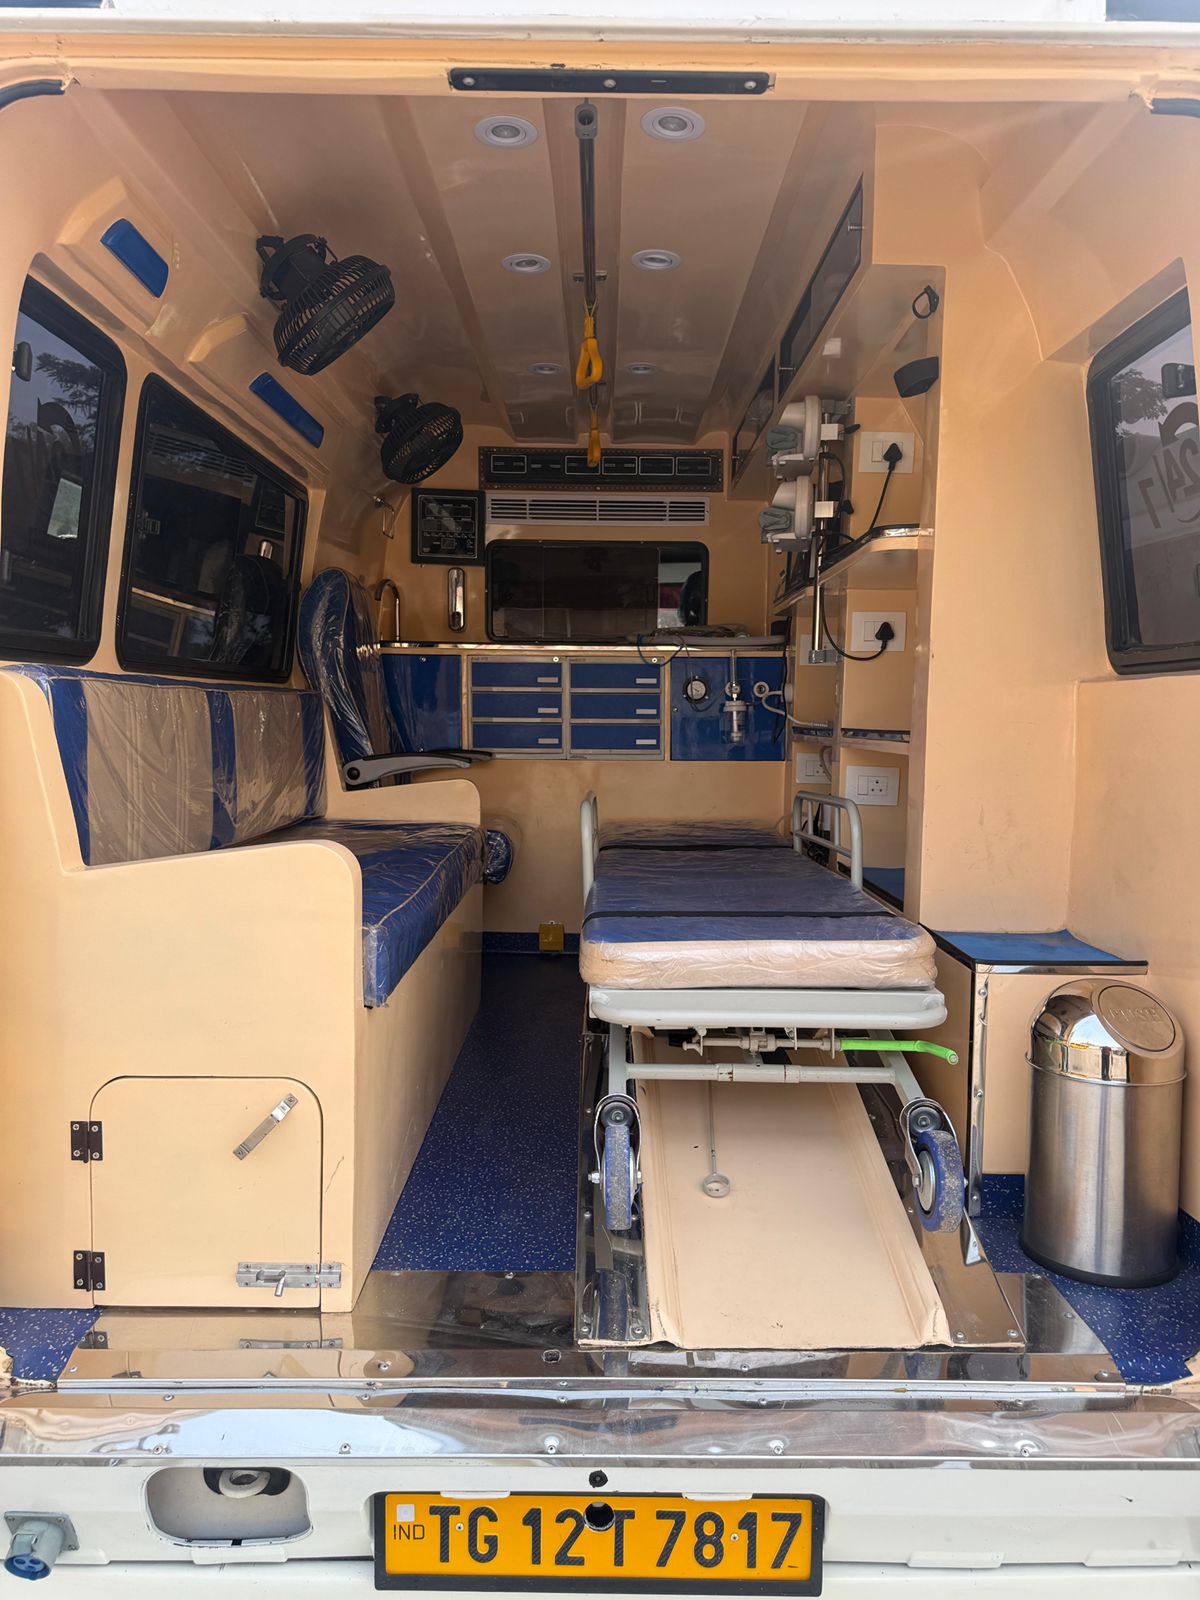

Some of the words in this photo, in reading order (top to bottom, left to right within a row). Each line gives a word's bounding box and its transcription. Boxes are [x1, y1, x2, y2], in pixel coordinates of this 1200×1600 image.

[393, 1524, 425, 1540] IND
[429, 1506, 499, 1564] TG
[522, 1507, 586, 1567] 12
[655, 1510, 802, 1569] 7817
